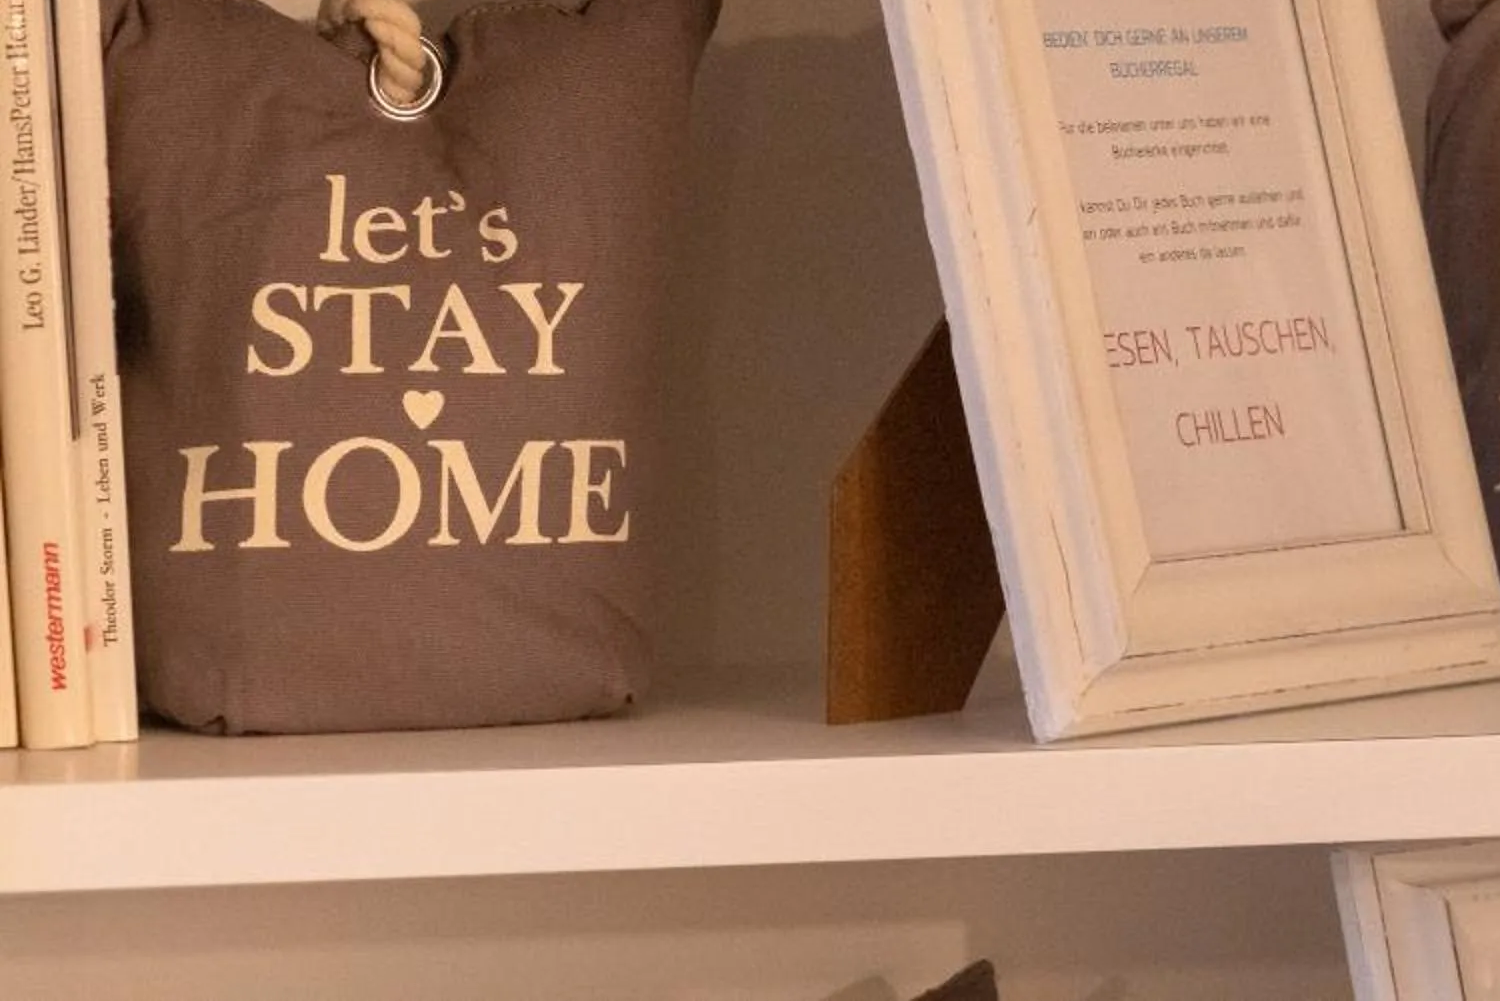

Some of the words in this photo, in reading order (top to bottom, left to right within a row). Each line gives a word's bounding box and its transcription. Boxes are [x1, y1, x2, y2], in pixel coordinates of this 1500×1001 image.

[319, 173, 519, 264] let's
[18, 262, 43, 284] G.
[20, 291, 45, 330] Leo
[247, 282, 585, 376] STAY
[89, 373, 108, 416] Werk
[92, 422, 109, 452] und
[1175, 403, 1286, 448] CHILLEN
[93, 458, 112, 503] Leben
[169, 436, 629, 552] HOME
[97, 527, 116, 575] Storm
[39, 542, 68, 691] westermann
[100, 579, 119, 648] Theodor
